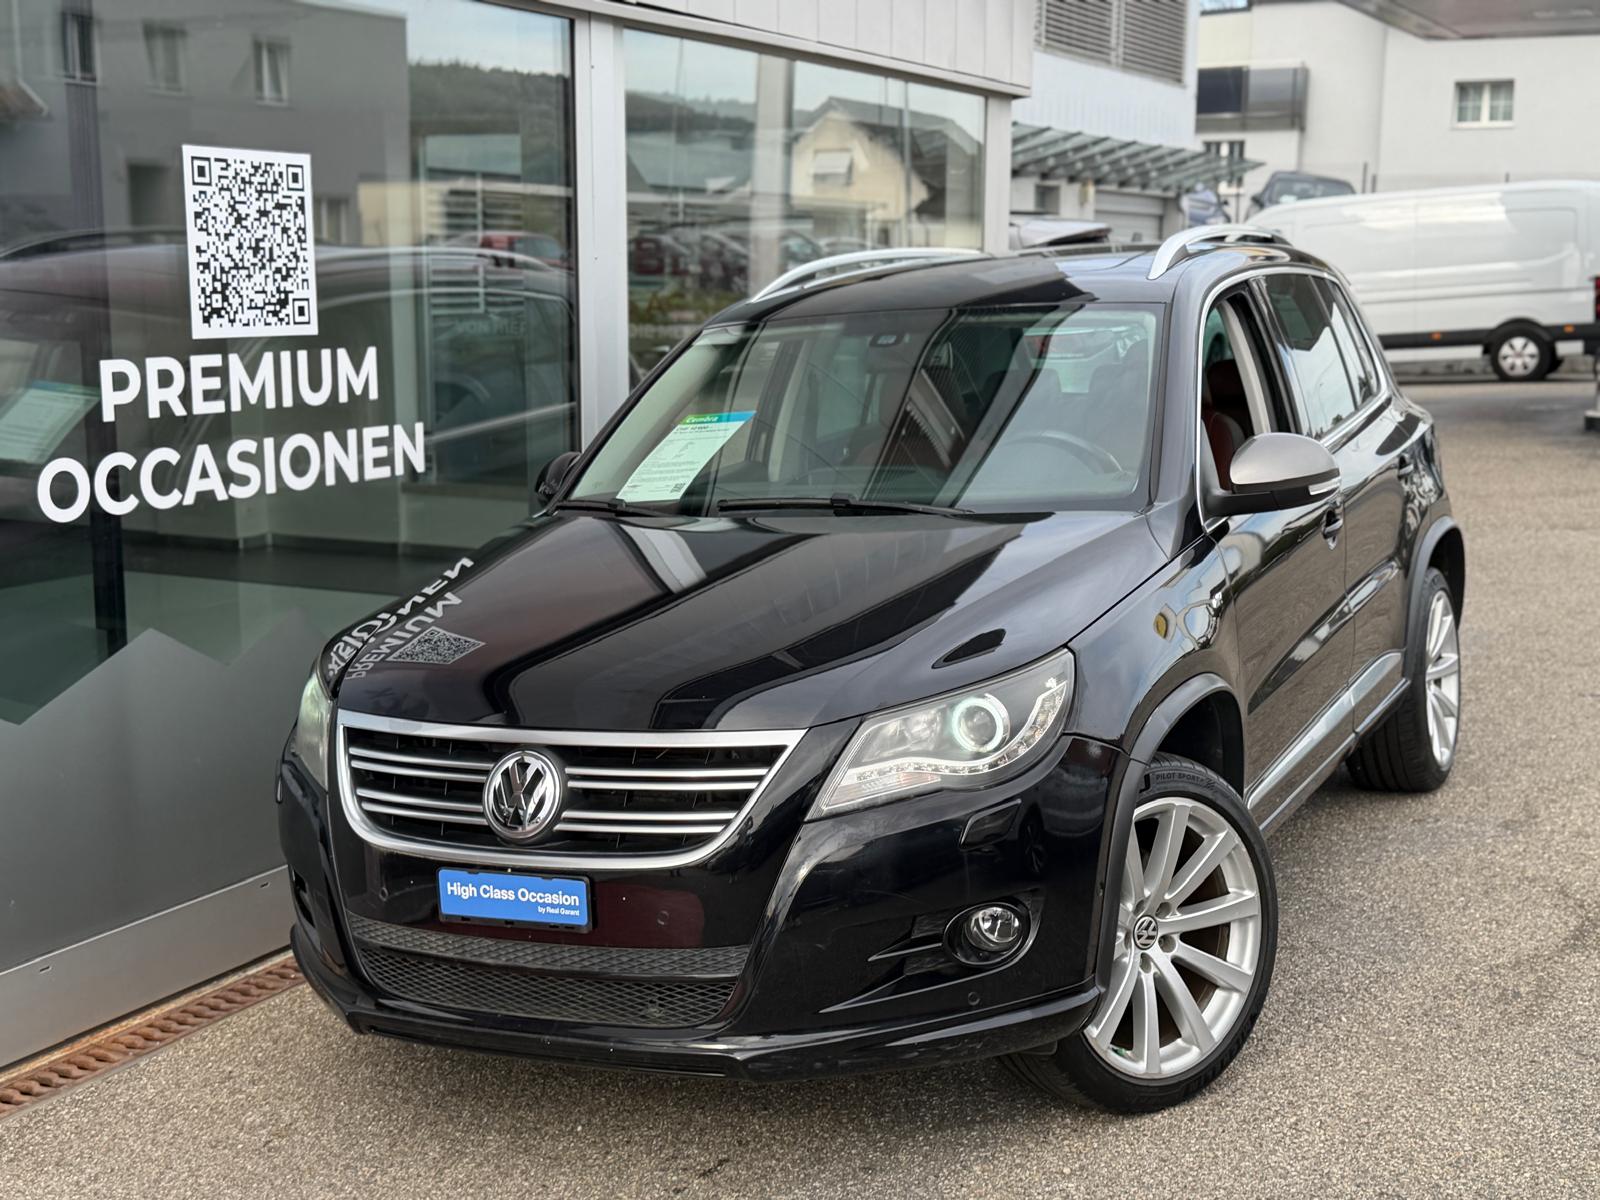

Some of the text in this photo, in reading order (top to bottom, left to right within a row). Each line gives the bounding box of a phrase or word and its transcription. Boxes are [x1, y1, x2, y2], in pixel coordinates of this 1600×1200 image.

[99, 346, 379, 423] PREMIUM
[37, 421, 426, 524] OCCASIONEN
[1155, 772, 1176, 781] PILOT
[447, 881, 580, 907] High Class Occasion
[537, 905, 580, 916] by Real Garant
